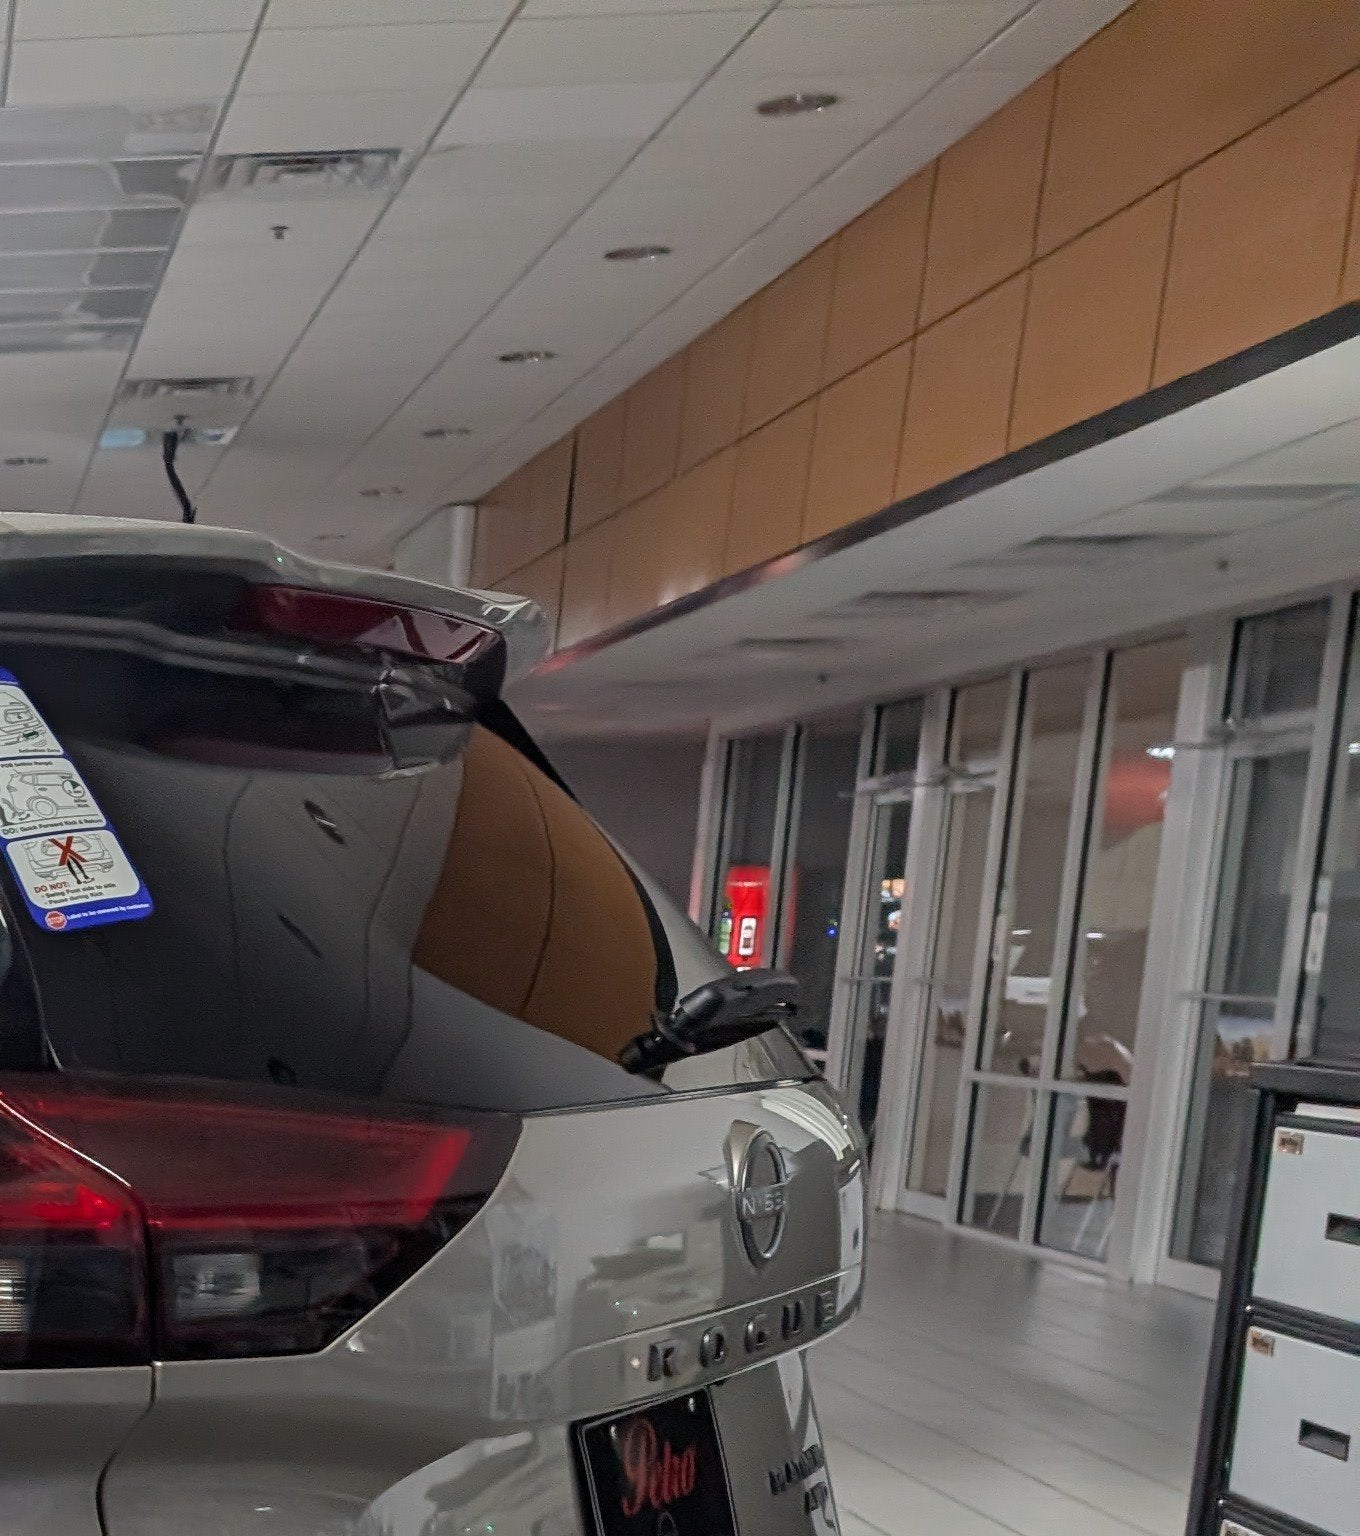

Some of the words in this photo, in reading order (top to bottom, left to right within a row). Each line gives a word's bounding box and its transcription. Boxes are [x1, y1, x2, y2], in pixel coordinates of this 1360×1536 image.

[39, 821, 64, 830] Forward
[34, 885, 48, 893] DO
[49, 881, 70, 890] NOT:
[45, 890, 65, 899] Swing
[646, 1290, 837, 1382] ROGUE
